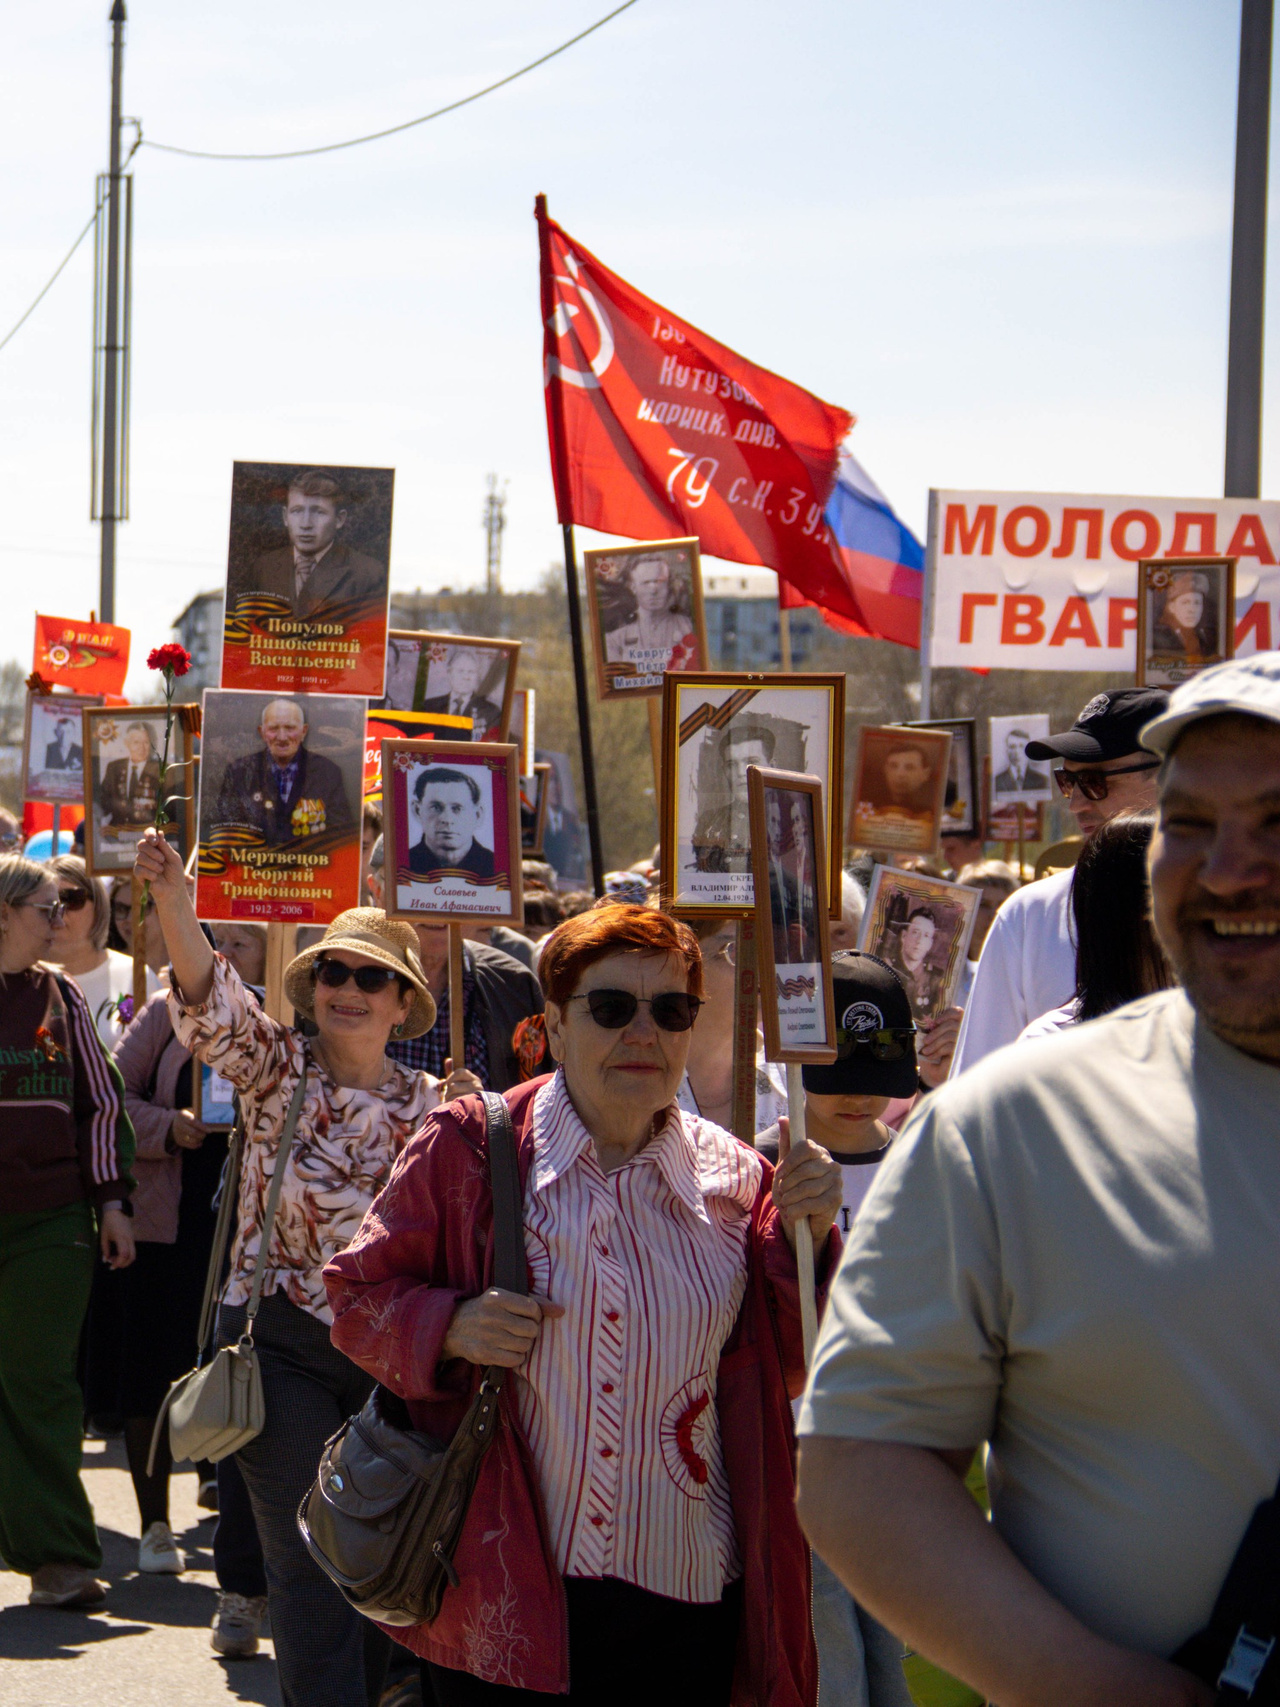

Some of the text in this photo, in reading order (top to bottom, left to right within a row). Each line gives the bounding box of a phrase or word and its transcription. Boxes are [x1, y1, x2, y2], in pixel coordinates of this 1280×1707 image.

[667, 448, 720, 508] 79
[942, 503, 1280, 567] МОЛОДА
[958, 592, 1280, 651] ГВАРИ
[249, 634, 361, 654] Иннокентий
[250, 650, 357, 670] Васильевич
[614, 675, 664, 688] Михайл
[230, 847, 330, 868] Мертвецов
[242, 865, 315, 884] Георгий
[730, 874, 753, 882] СКРЕ
[220, 881, 333, 900] Трифонович
[691, 884, 738, 892] ВЛАДИМИР
[250, 904, 272, 914] 1912
[280, 904, 303, 915] 2006
[410, 898, 438, 910] Иван
